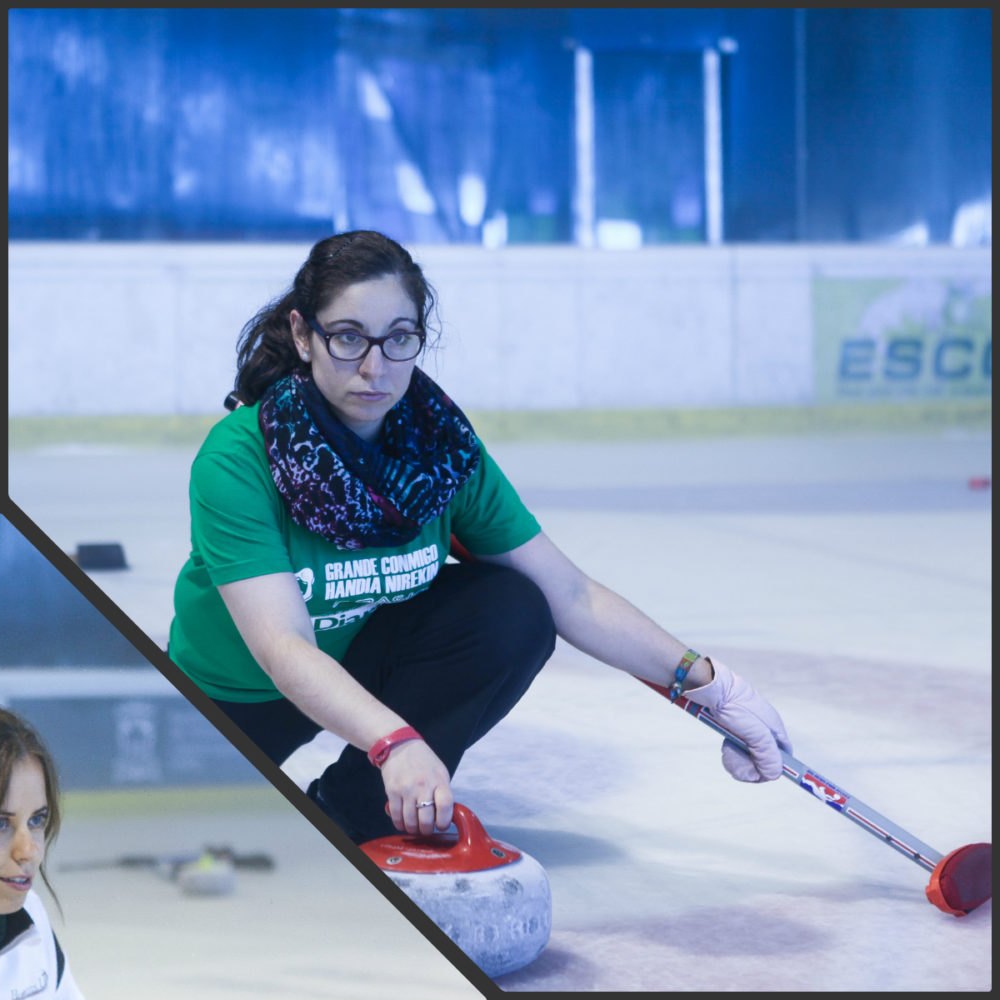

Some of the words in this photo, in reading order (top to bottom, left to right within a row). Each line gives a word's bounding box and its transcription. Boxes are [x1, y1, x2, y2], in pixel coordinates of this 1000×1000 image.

[325, 558, 379, 582] GRANDE
[380, 544, 439, 576] CONMIGO
[325, 576, 382, 600] HANDIA
